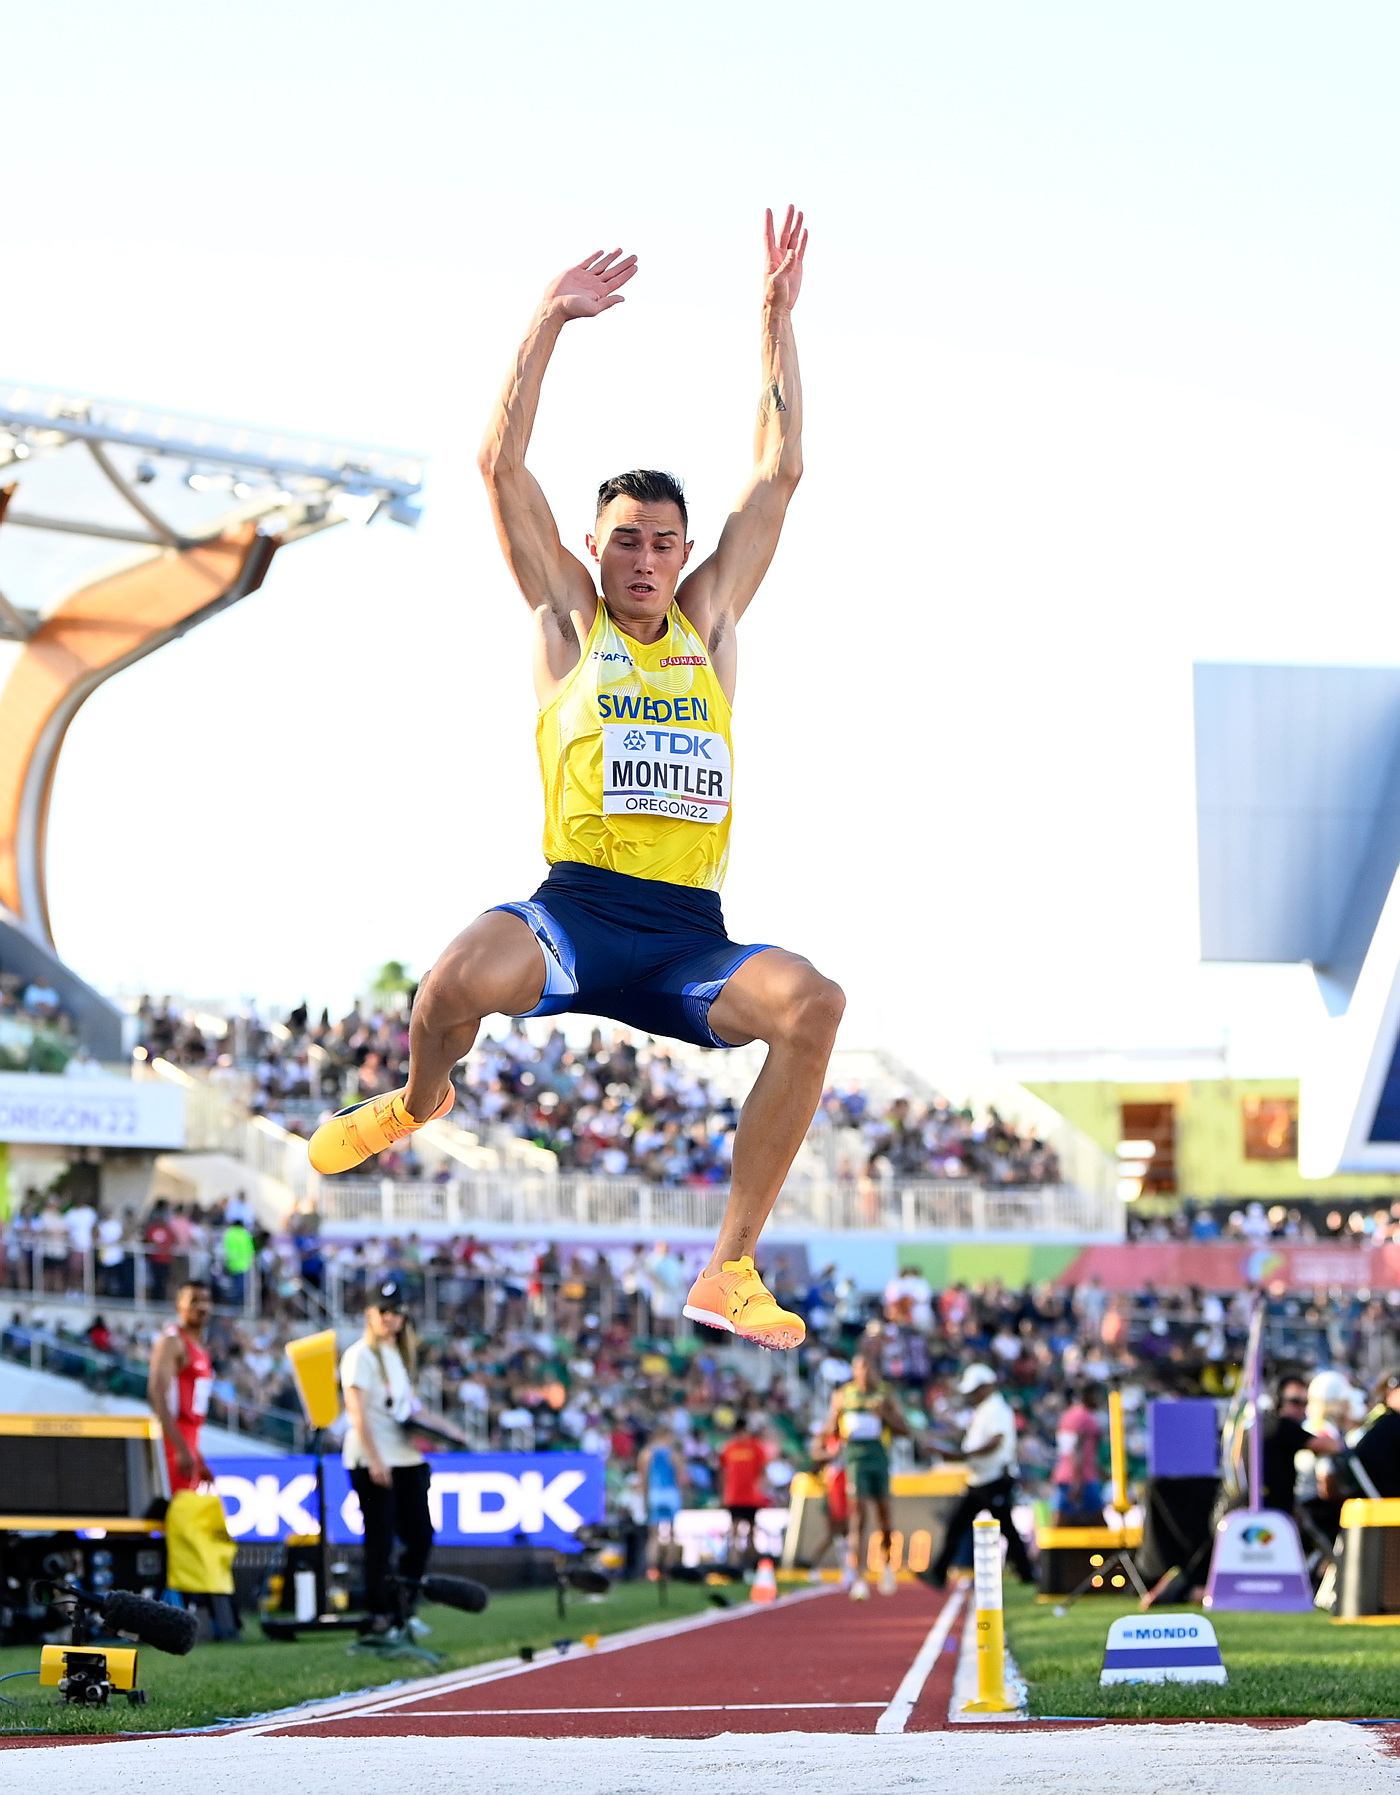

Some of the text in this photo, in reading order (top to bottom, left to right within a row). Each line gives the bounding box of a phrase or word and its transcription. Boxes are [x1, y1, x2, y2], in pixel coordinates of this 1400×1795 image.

[598, 694, 708, 722] SWEDEN
[646, 730, 713, 760] TDK
[612, 760, 724, 797] MONTLER
[625, 798, 708, 819] OREGON22
[206, 1474, 321, 1536] DK
[1136, 1627, 1198, 1639] MONDO
